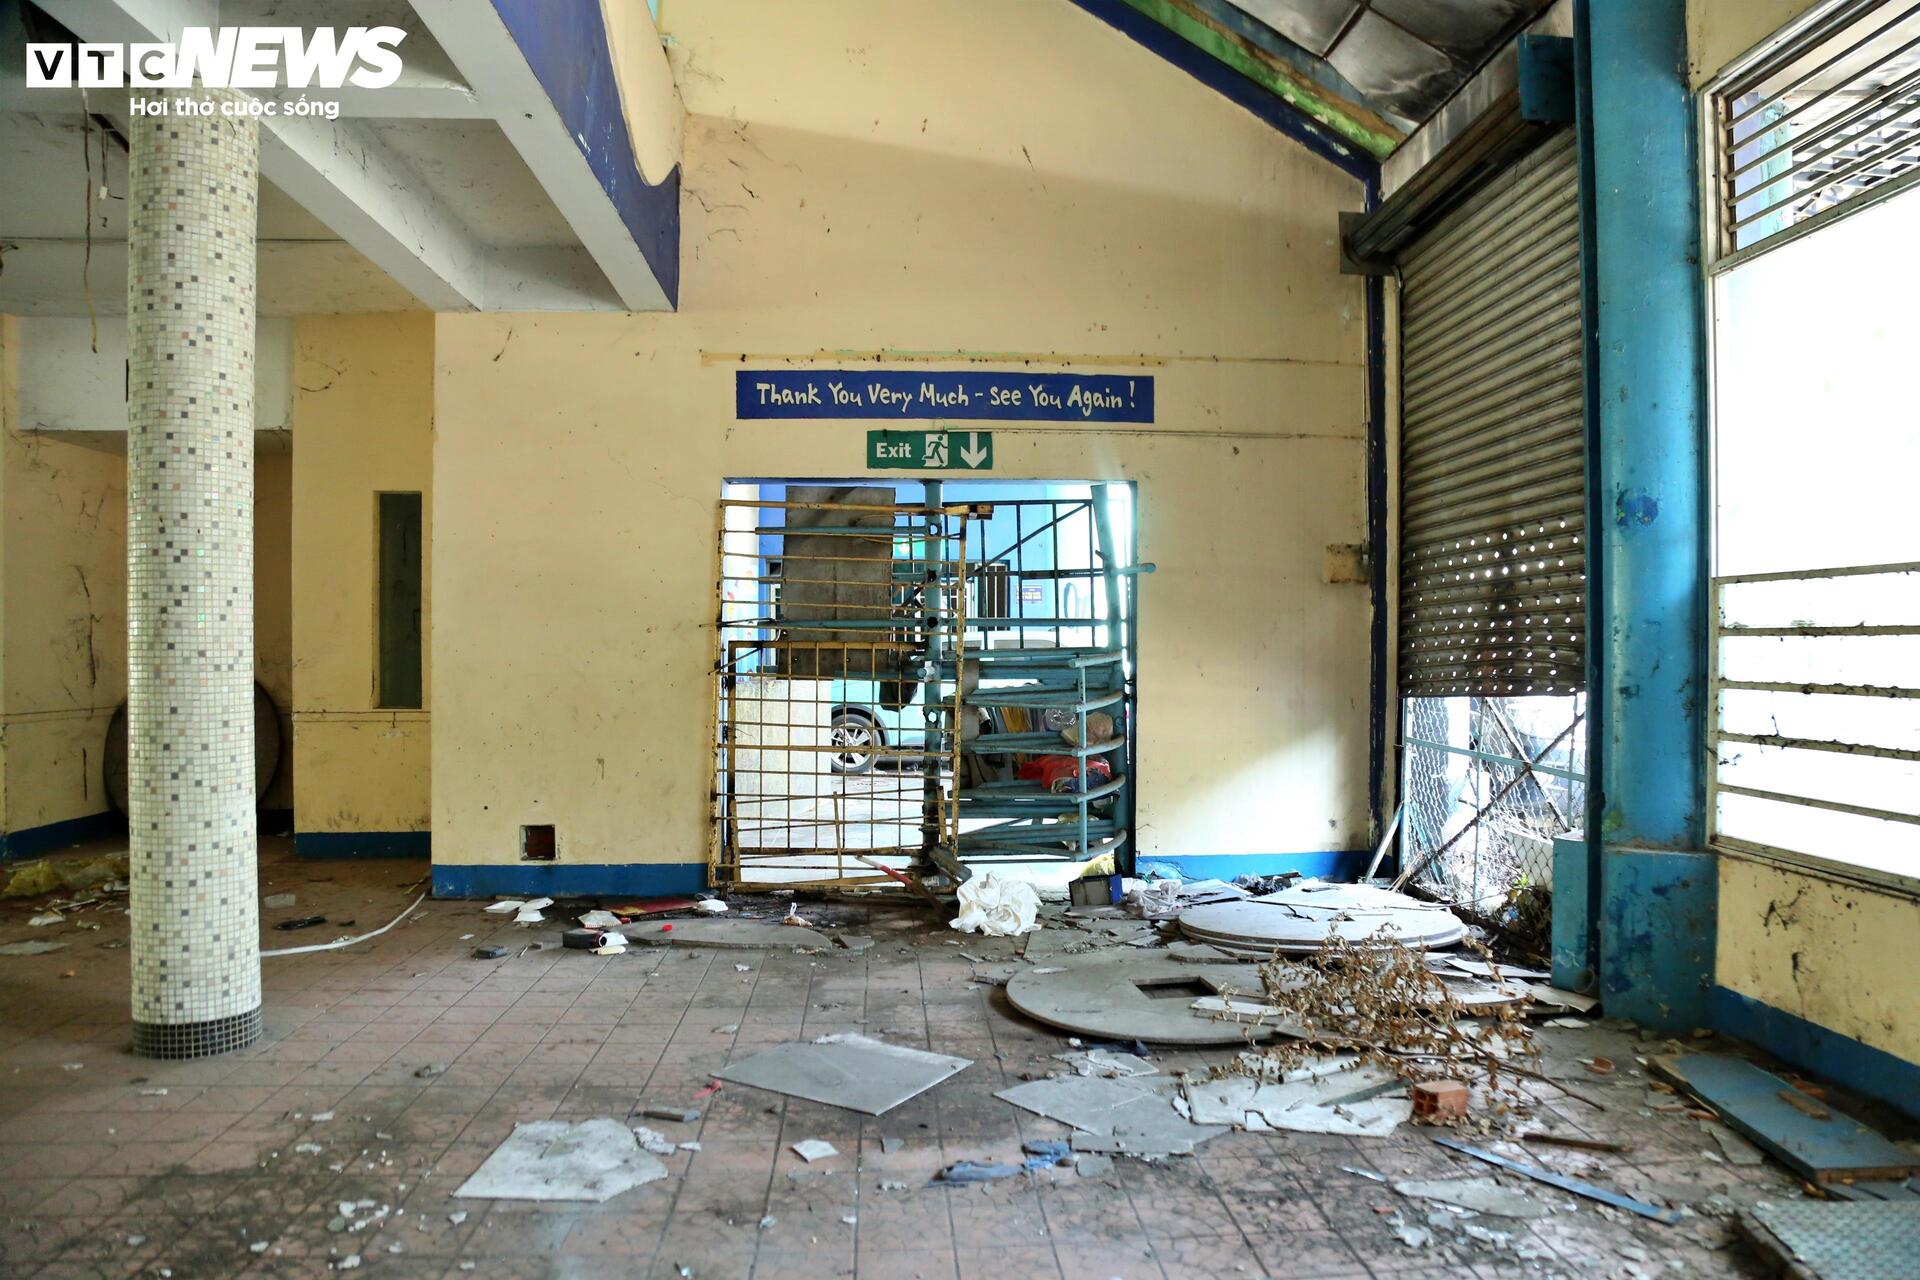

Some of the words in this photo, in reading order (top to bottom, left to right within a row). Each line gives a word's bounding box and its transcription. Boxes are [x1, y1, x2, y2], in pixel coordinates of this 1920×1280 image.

[756, 382, 822, 405] Thank
[828, 382, 863, 407] You
[867, 383, 913, 413] Very
[919, 382, 969, 407] Much
[1028, 384, 1062, 409] You
[876, 442, 912, 458] Exit
